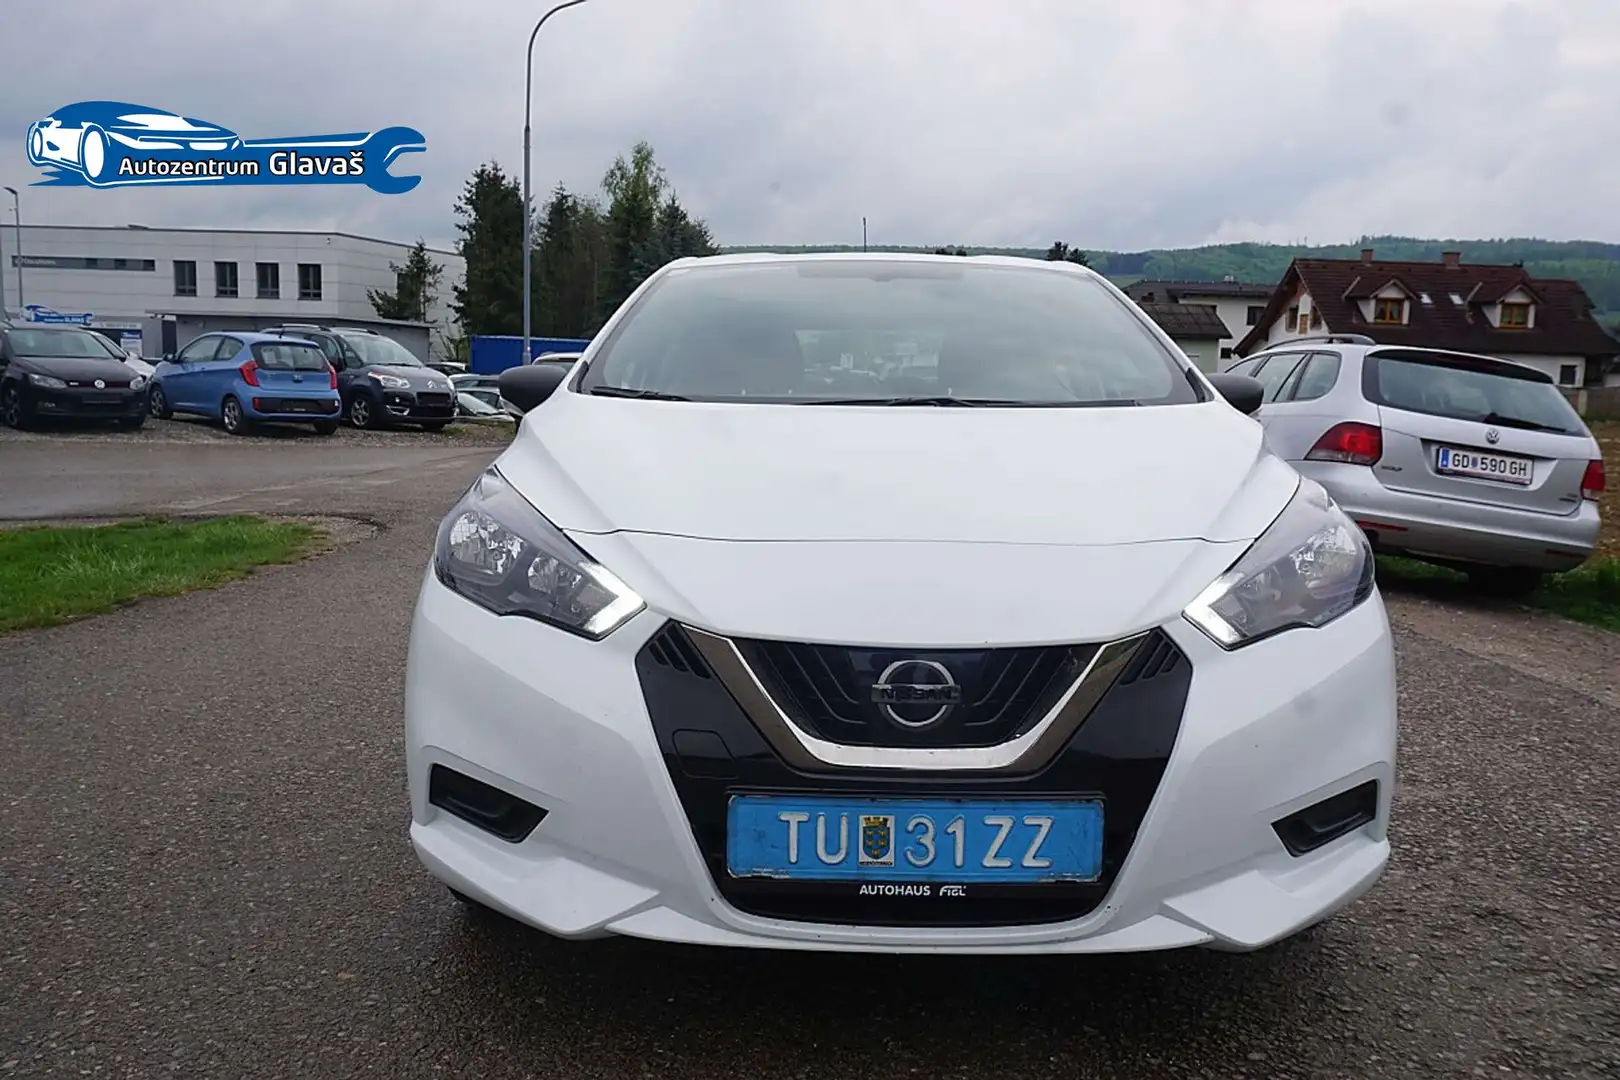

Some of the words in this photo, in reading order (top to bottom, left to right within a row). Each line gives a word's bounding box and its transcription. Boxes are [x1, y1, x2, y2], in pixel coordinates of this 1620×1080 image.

[1452, 453, 1470, 468] GD
[778, 811, 849, 866] TU
[859, 884, 931, 896] AUTOHAUS
